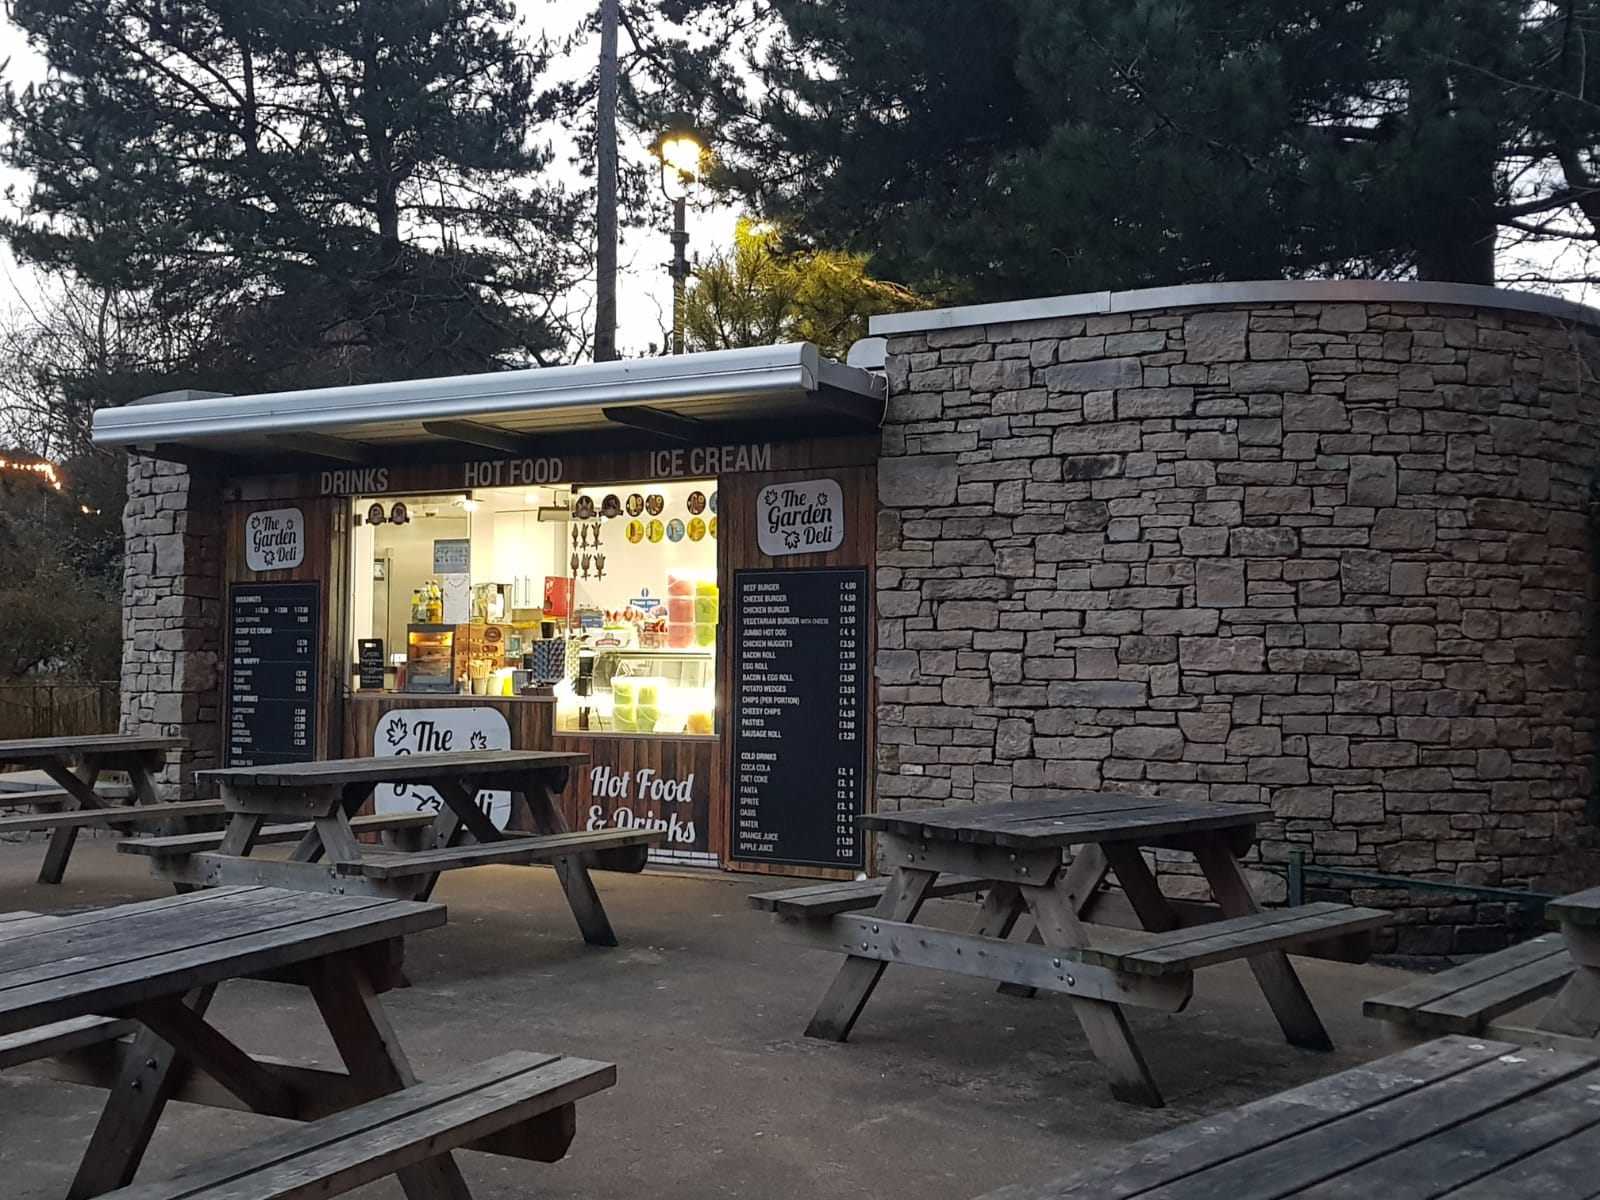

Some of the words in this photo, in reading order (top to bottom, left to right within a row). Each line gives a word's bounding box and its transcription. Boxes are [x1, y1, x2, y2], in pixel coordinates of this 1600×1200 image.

[650, 450, 684, 477] ICE
[690, 443, 771, 475] CREAM
[464, 460, 504, 486] HOT
[509, 458, 563, 484] FOOD
[320, 467, 389, 494] DRINKS
[781, 490, 807, 507] The
[262, 516, 280, 531] The
[768, 504, 832, 534] Garden
[803, 526, 833, 545] Deli
[253, 529, 296, 552] Garden
[276, 546, 297, 562] Deli
[743, 584, 757, 592] BEEF
[743, 595, 764, 603] CHEESE
[743, 606, 767, 614] CHICKEN
[767, 606, 790, 614] BURGER
[743, 617, 776, 625] VEGETARIAN
[777, 617, 800, 625] BURGER
[763, 628, 774, 636] HOT
[775, 628, 787, 636] DOG
[742, 651, 761, 659] BACON
[762, 651, 776, 659] ROLL
[742, 662, 754, 670] EGG
[754, 662, 768, 670] ROLL
[779, 674, 794, 682] ROLL
[763, 685, 786, 693] WEDGES
[742, 696, 759, 704] CHIPS
[760, 696, 773, 705] (PER
[773, 696, 800, 706] PORTION)
[742, 707, 763, 715] CHEESY
[742, 718, 764, 726] PASTIES
[413, 721, 453, 752] The
[742, 730, 767, 738] SAUSAGE
[768, 730, 782, 738] ROLL
[741, 752, 756, 760] COLD
[756, 753, 777, 761] DRINKS
[741, 763, 756, 771] COCA
[756, 764, 771, 772] COLA
[740, 774, 753, 783] DIET
[753, 775, 768, 783] COKE
[590, 766, 630, 798] Hot
[636, 768, 694, 802] Food
[740, 786, 758, 794] FANTA
[740, 797, 759, 806] SPRITE
[740, 808, 756, 817] OASIS
[740, 820, 758, 828] WATER
[740, 831, 762, 840] ORANGE
[762, 833, 778, 841] JUICE
[740, 842, 757, 851] APPLE
[758, 844, 773, 852] JUICE
